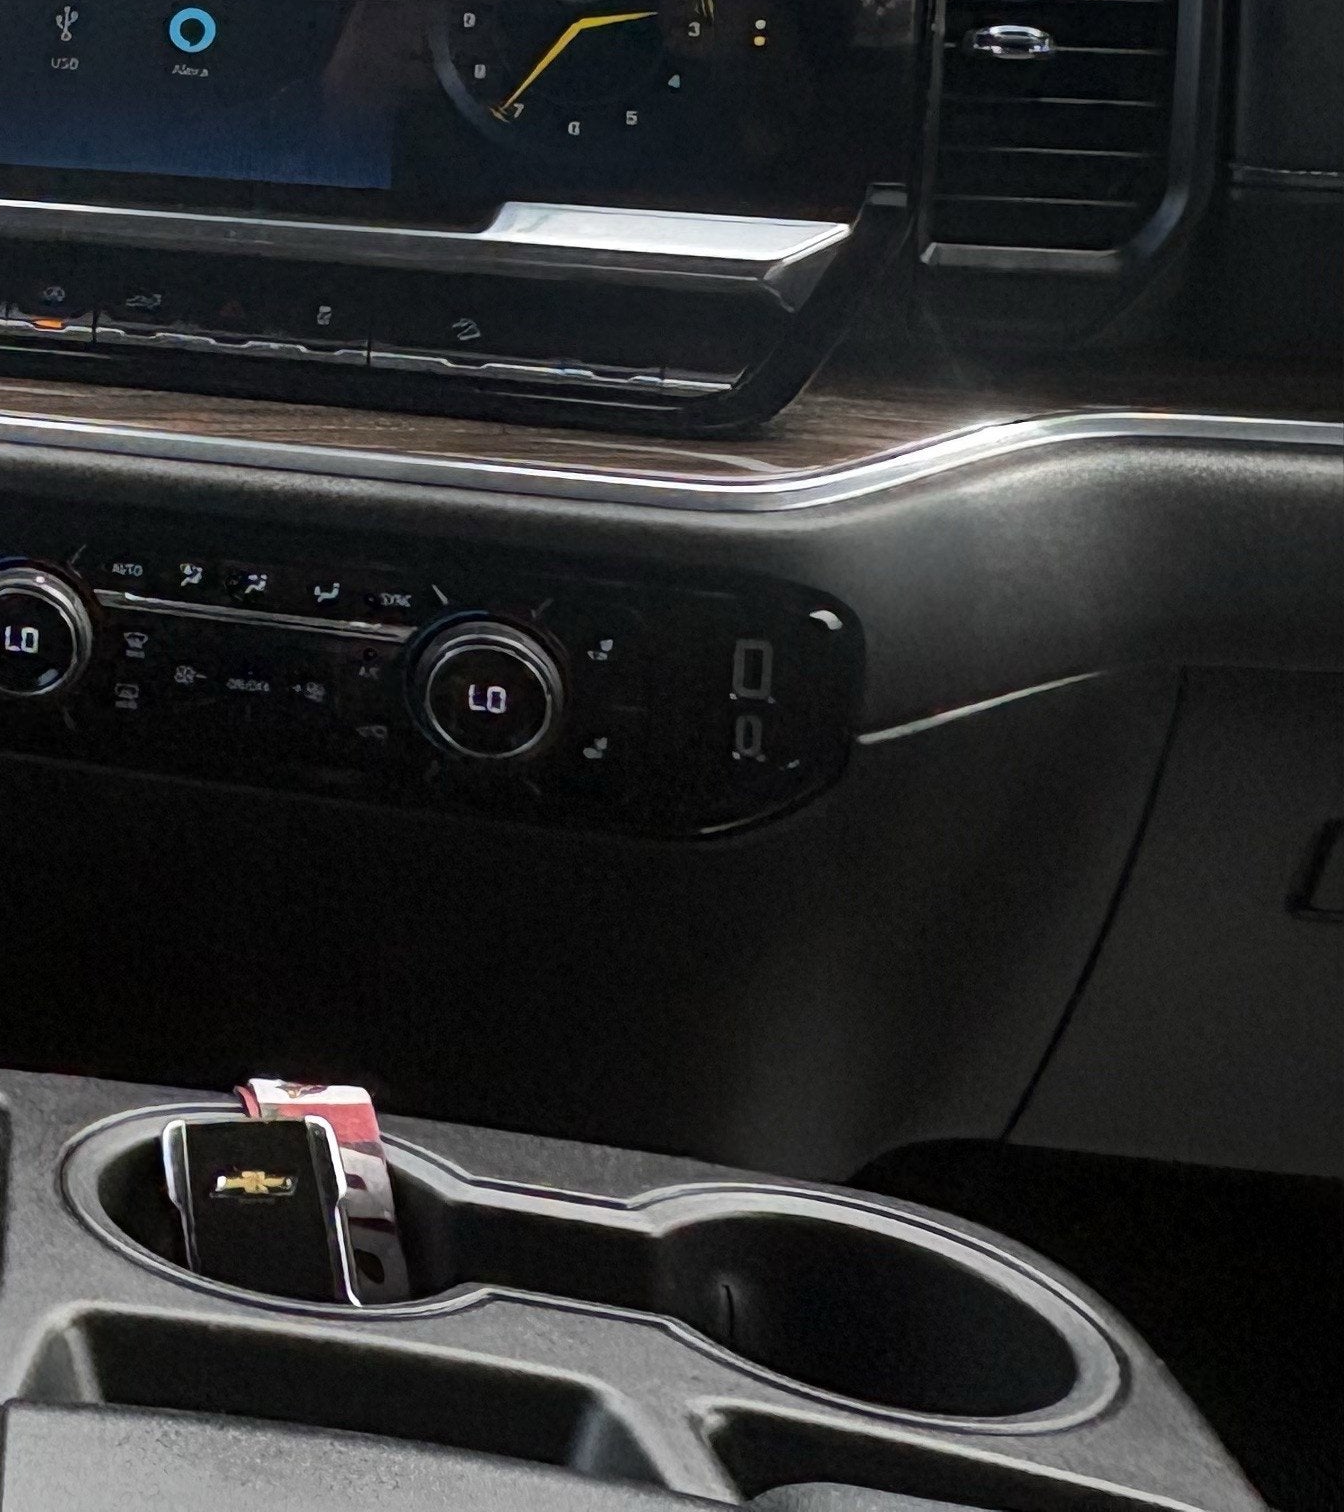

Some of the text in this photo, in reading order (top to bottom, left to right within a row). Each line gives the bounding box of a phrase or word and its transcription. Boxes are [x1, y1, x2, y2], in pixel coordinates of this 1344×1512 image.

[688, 21, 701, 37] 3
[667, 73, 681, 89] 4
[513, 103, 525, 119] 7
[626, 110, 638, 126] 5
[111, 562, 144, 577] AUTO
[4, 625, 39, 654] LO
[468, 684, 507, 714] LO
